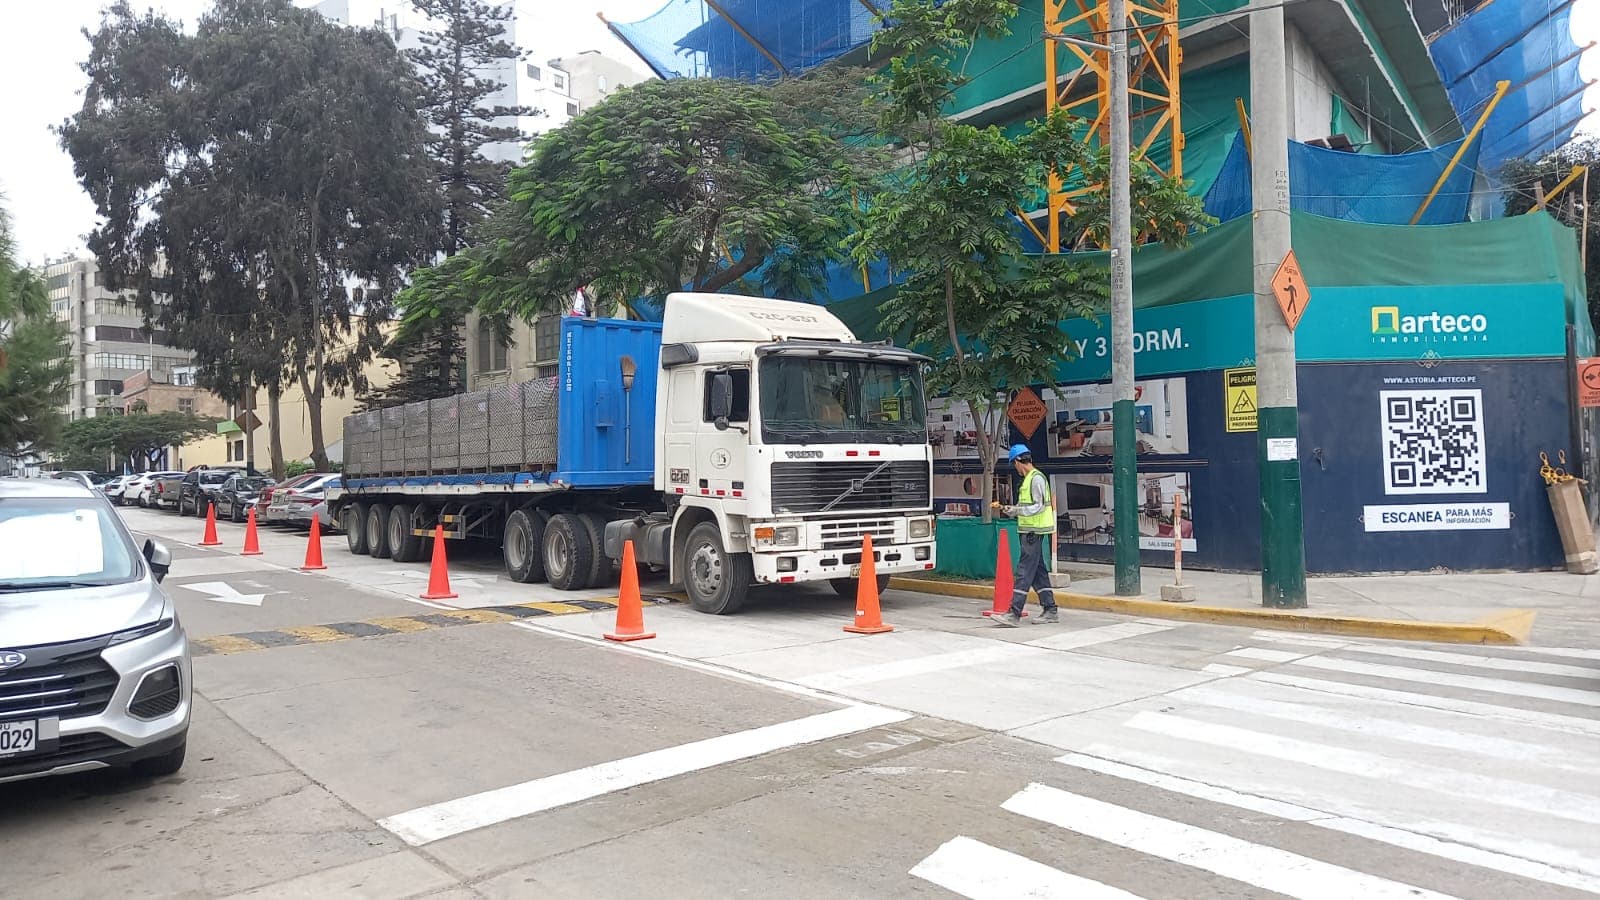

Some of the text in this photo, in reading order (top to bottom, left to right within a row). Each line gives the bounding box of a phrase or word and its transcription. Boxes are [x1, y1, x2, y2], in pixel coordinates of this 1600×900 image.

[1401, 311, 1487, 333] arteco
[1075, 338, 1088, 358] Y
[1095, 337, 1107, 357] 3
[1133, 327, 1189, 353] ORM.
[1372, 335, 1487, 343] INMOBILIARIA
[1230, 375, 1257, 384] PELIGRO
[1383, 376, 1477, 384] WWW.ASTORIA.ARTECO.PE
[1382, 506, 1493, 523] ESCANEA PARA MÁS
[0, 728, 33, 750] 029
